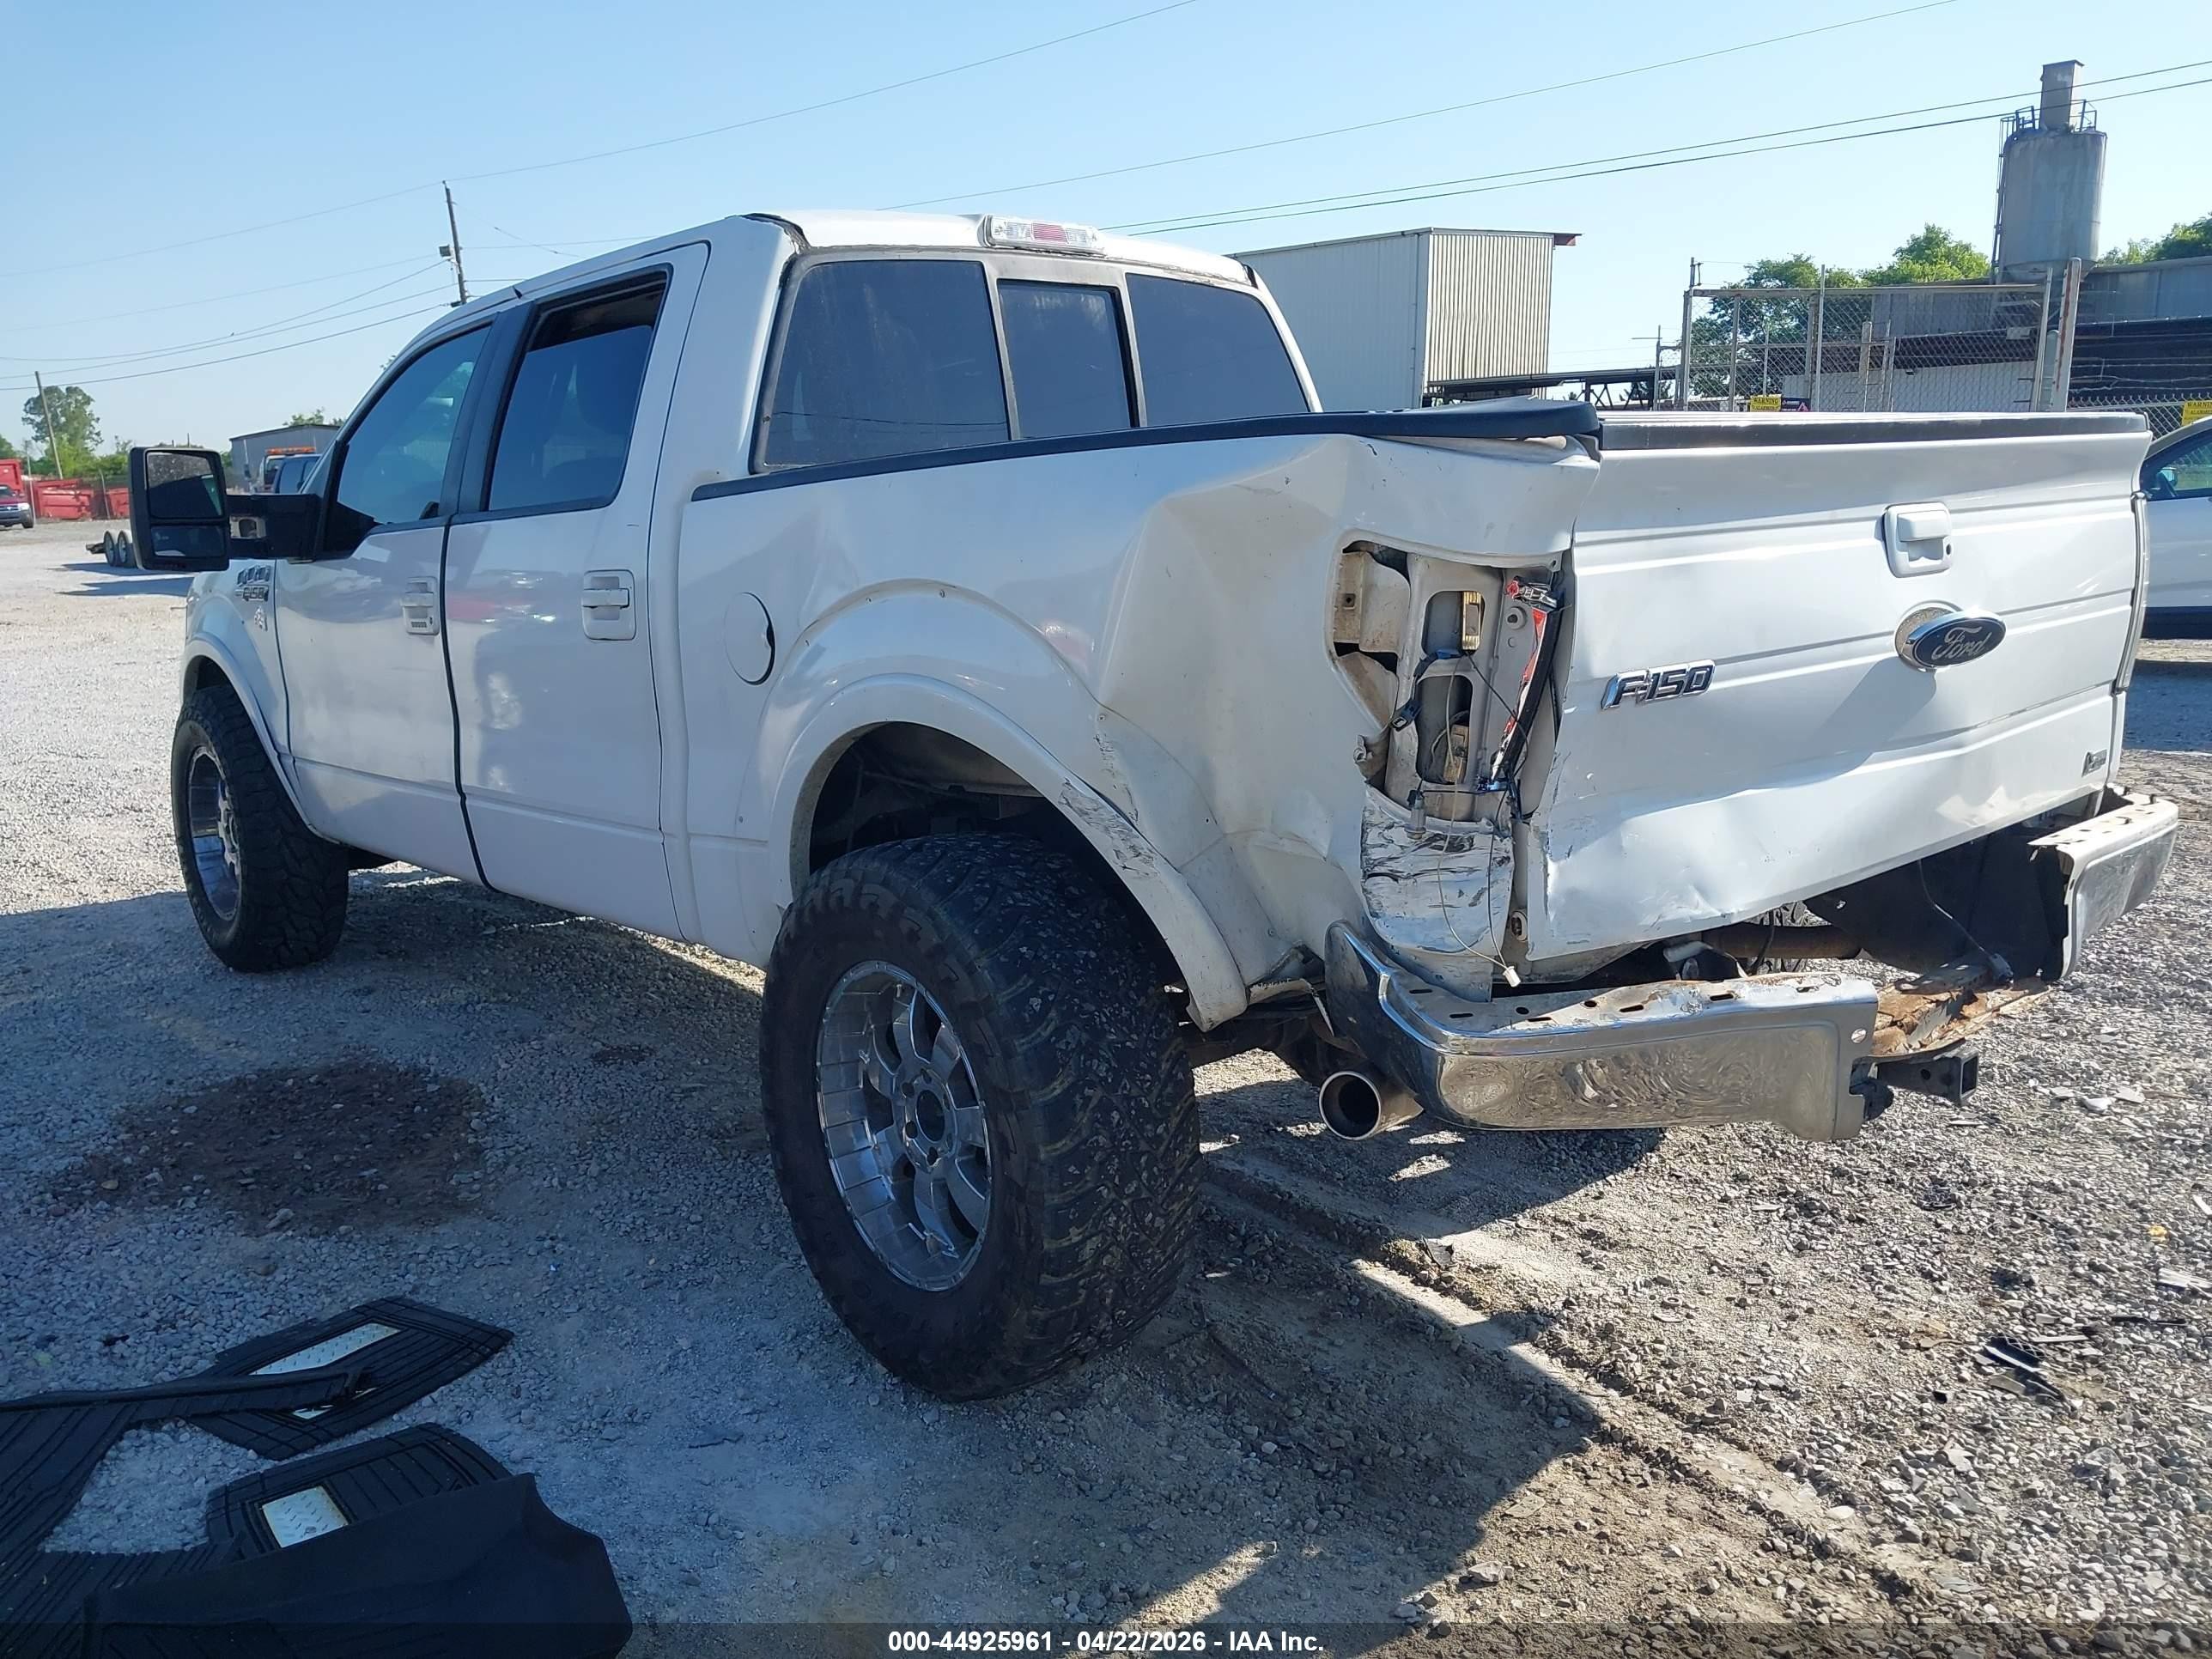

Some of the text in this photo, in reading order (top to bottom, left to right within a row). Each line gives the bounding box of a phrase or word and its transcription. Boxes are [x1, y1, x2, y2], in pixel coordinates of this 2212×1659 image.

[1753, 397, 1779, 405] WARNING
[1930, 626, 1992, 660] Ford
[1601, 659, 1716, 710] F-150
